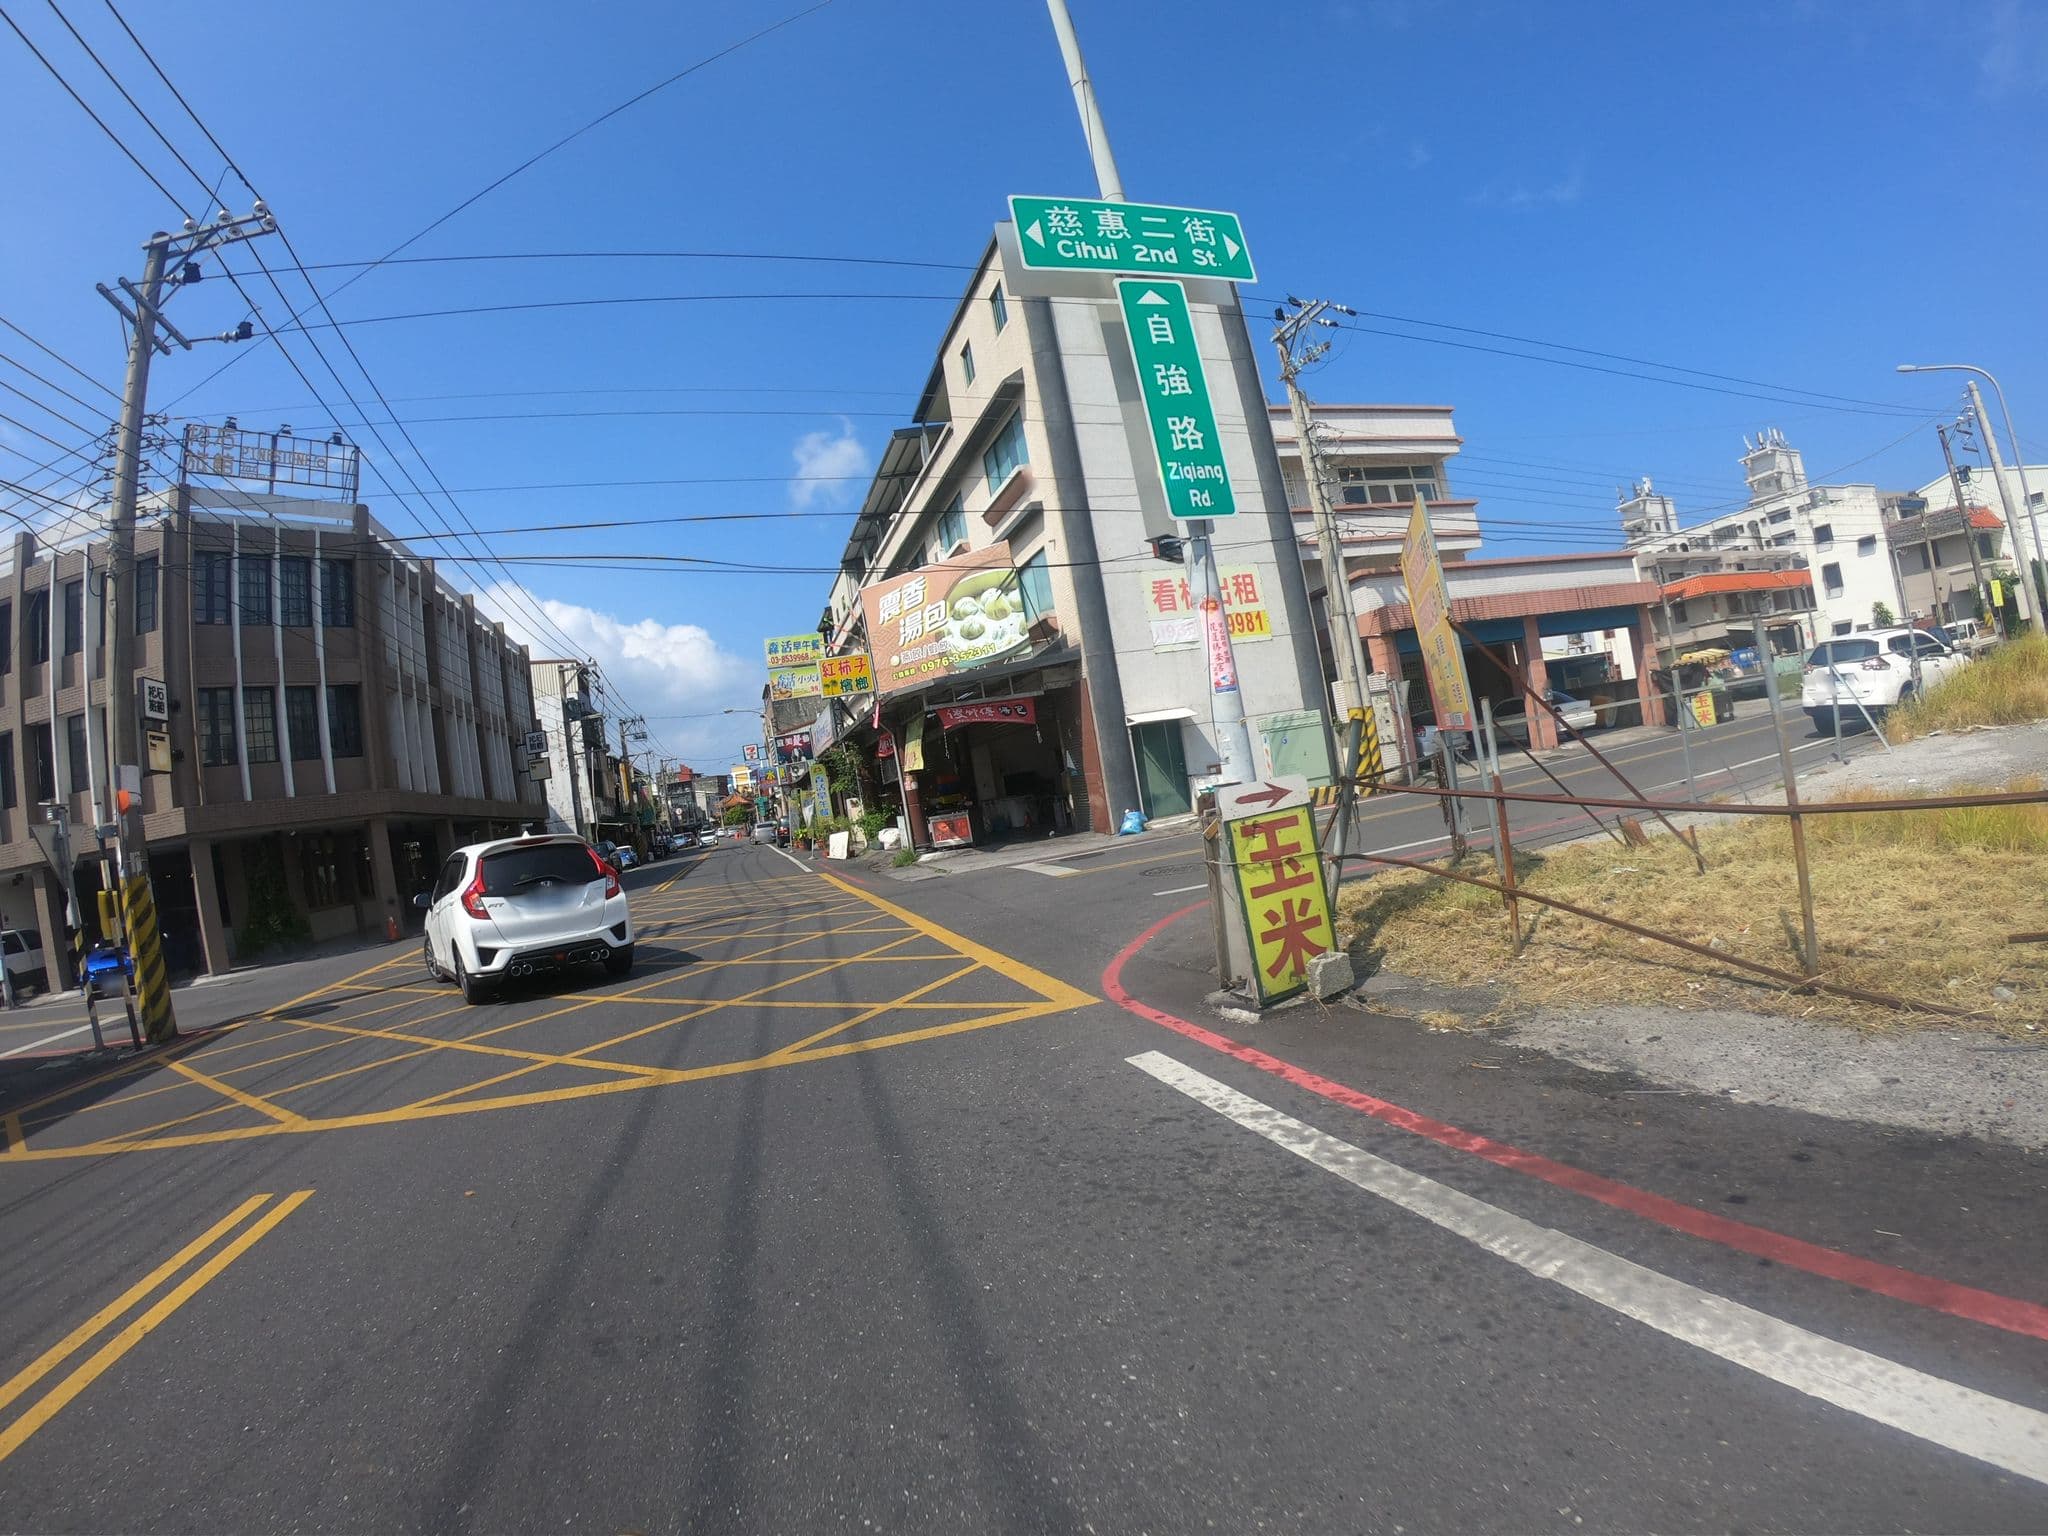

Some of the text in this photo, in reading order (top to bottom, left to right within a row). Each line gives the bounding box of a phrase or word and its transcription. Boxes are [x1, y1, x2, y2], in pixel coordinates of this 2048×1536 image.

[1045, 205, 1216, 247] 慈惠二街
[1056, 239, 1222, 268] Cihui 2nd St.
[1146, 312, 1205, 452] 自強路
[1166, 461, 1224, 485] Ziqiang
[1190, 488, 1215, 508] Rd.
[898, 599, 948, 647] 湯包
[822, 657, 867, 678] 紅柿子
[840, 676, 869, 693] 檳榔
[1240, 814, 1329, 980] 玉米
